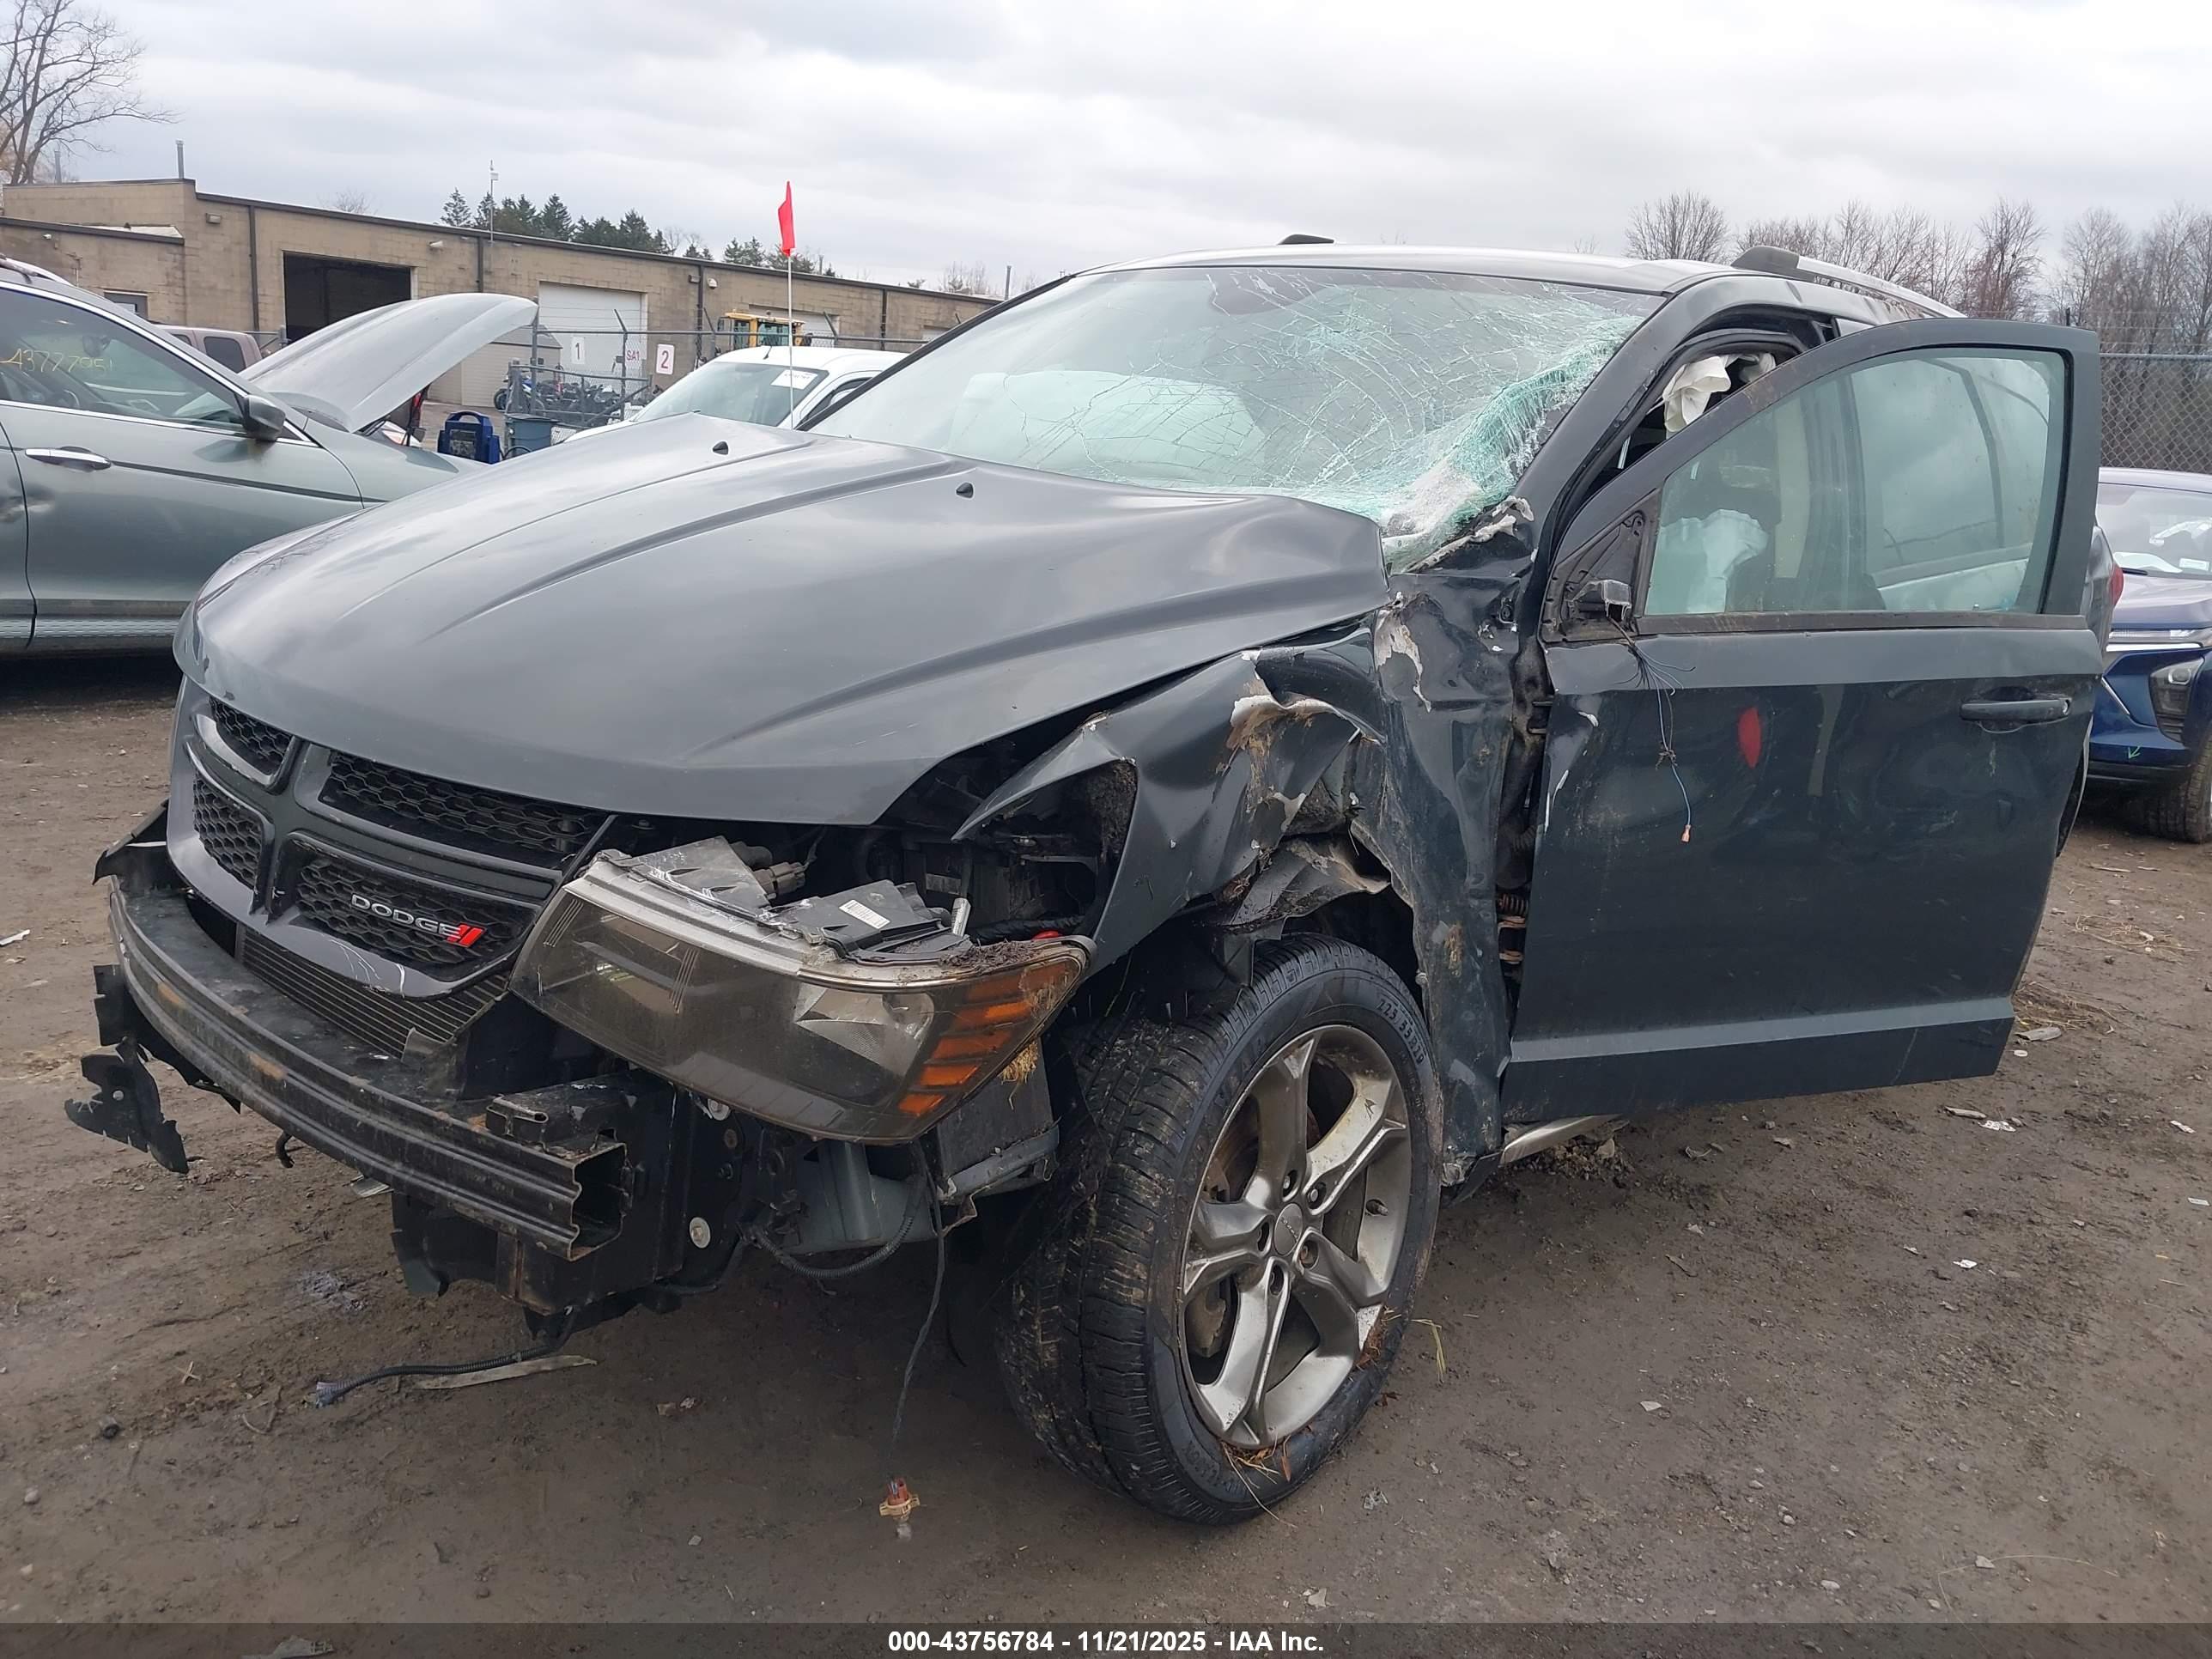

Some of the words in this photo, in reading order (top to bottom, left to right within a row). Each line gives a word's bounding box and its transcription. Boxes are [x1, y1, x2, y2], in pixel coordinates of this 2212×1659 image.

[574, 343, 580, 360] 1
[660, 350, 670, 369] 2
[350, 893, 463, 940] DODGE
